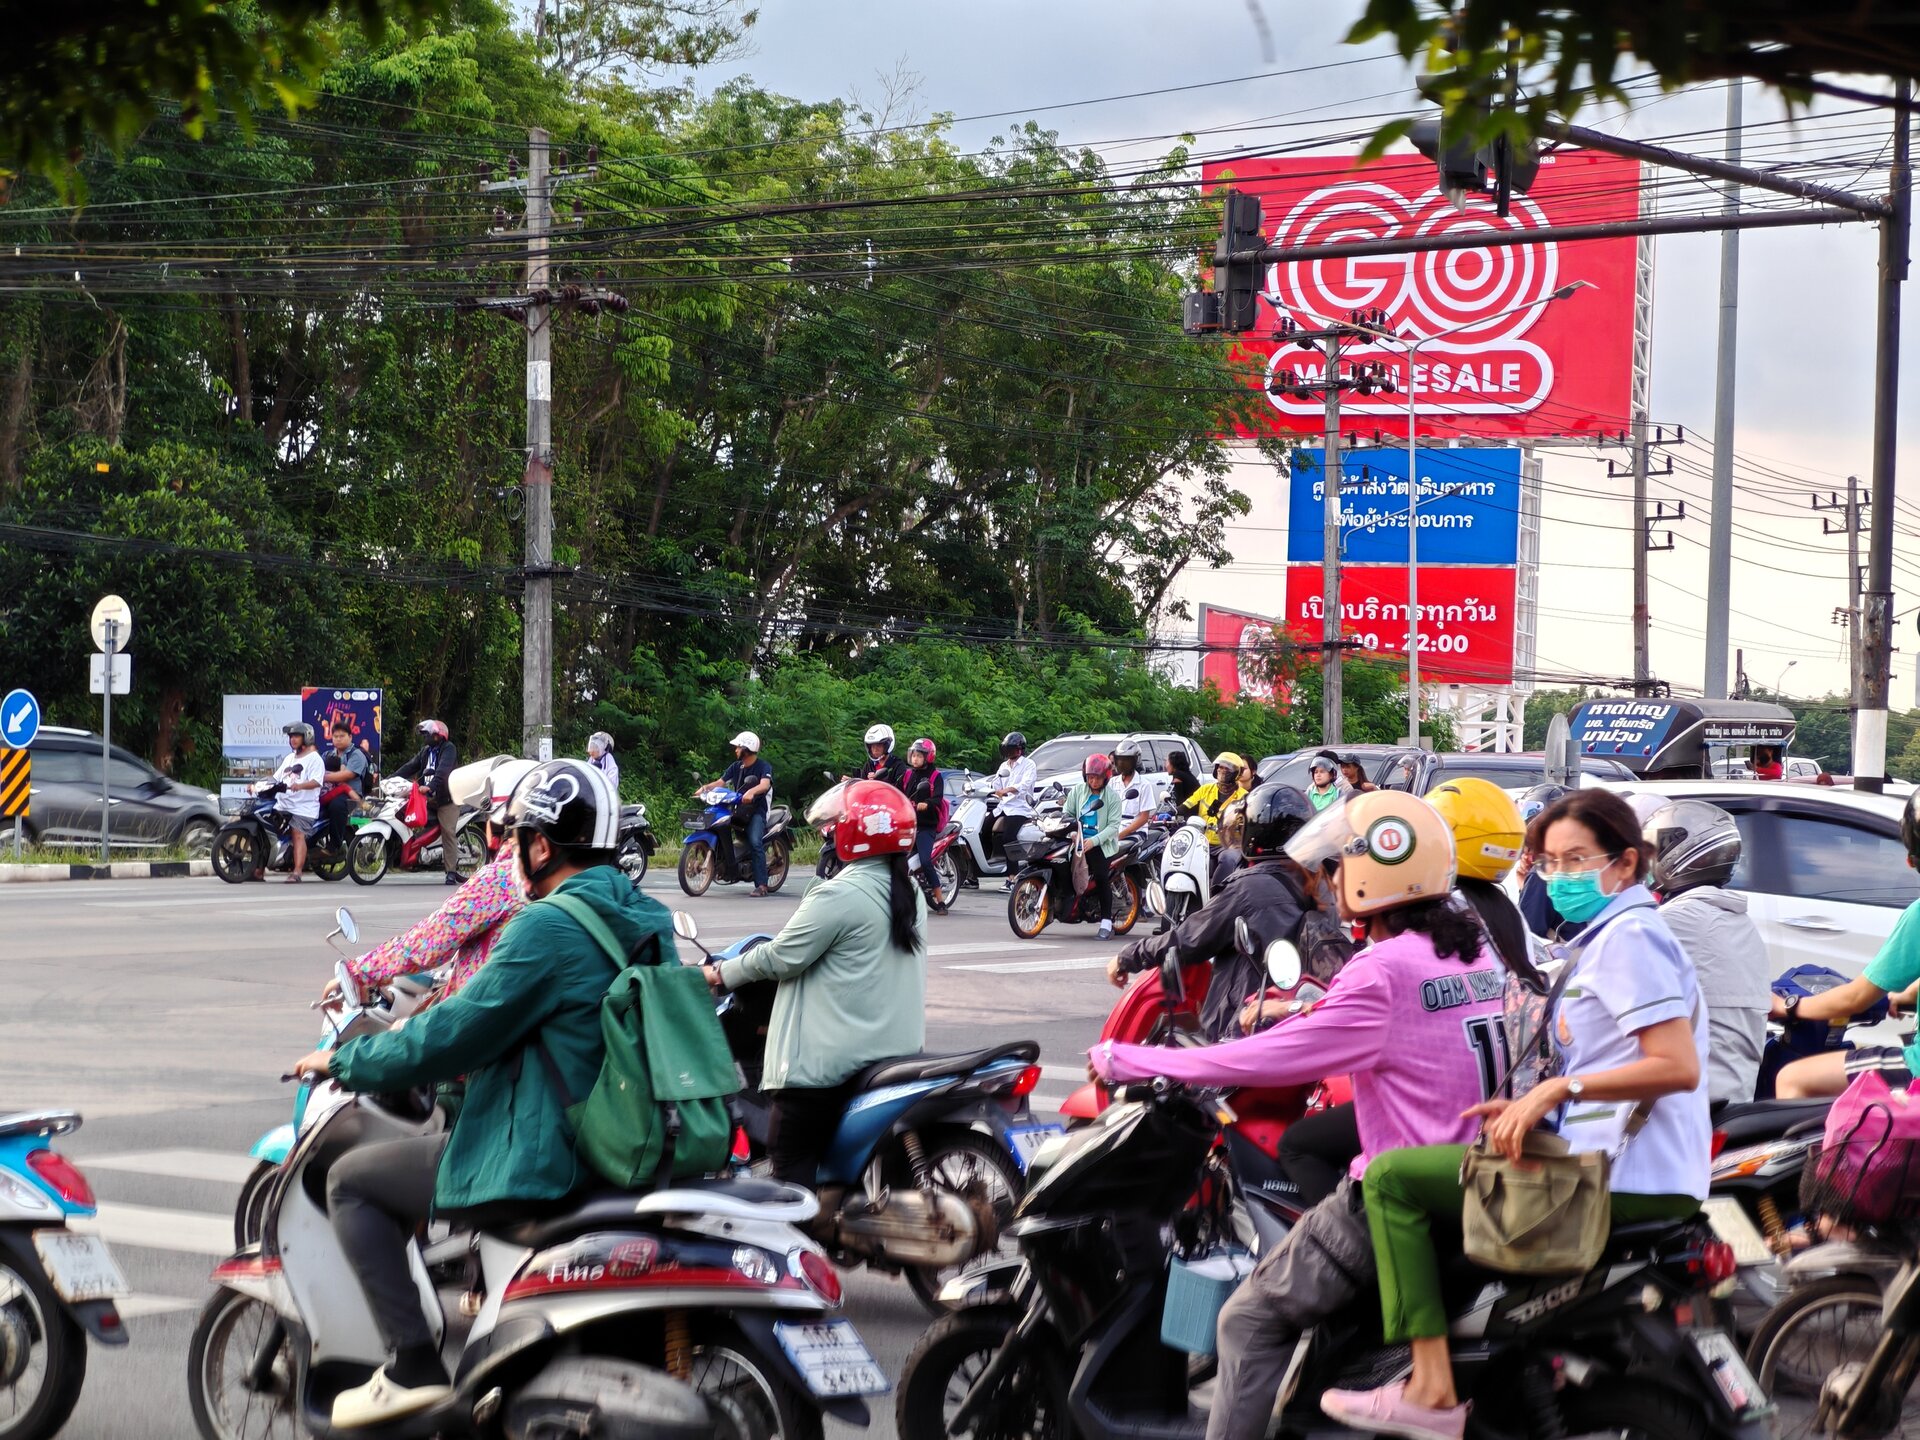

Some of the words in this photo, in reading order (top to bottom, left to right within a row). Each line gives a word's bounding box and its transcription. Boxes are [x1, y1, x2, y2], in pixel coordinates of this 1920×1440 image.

[1268, 181, 1558, 344] GO
[1301, 596, 1496, 629] เปิบริการทุกวัน
[247, 715, 271, 727] Soft
[1588, 701, 1671, 719] หาดใหญ่
[1420, 974, 1471, 1012] OHM
